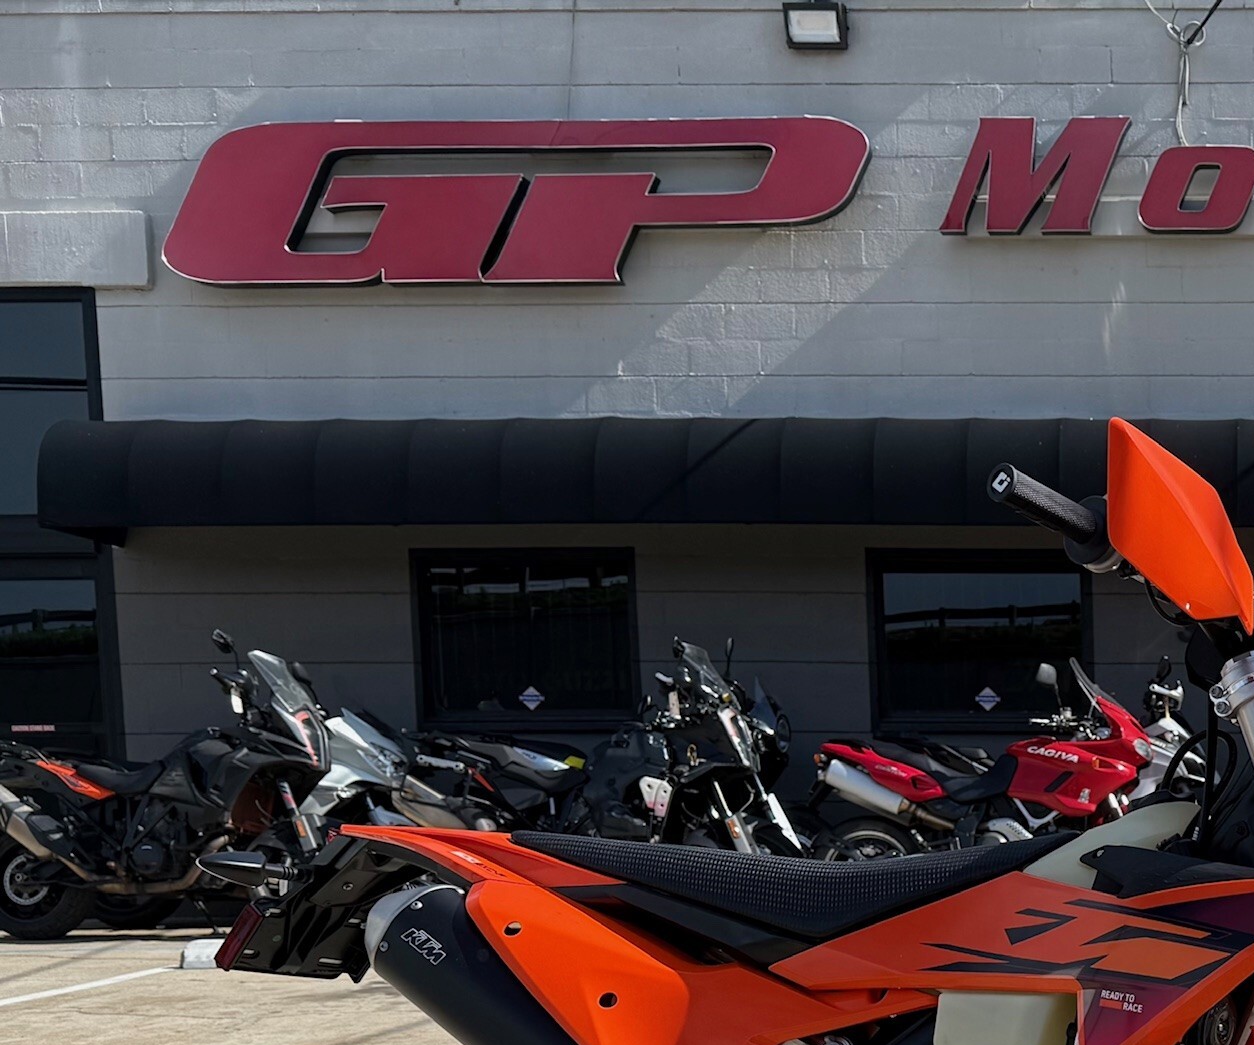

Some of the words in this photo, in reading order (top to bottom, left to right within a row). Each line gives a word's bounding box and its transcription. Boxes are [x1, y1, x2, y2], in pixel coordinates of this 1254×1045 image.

[162, 114, 871, 287] GP
[1026, 745, 1080, 764] CAGIVA
[400, 927, 447, 966] KTM
[1101, 990, 1125, 1001] READY
[1125, 994, 1135, 1003] TO
[1122, 1001, 1144, 1014] RACE
